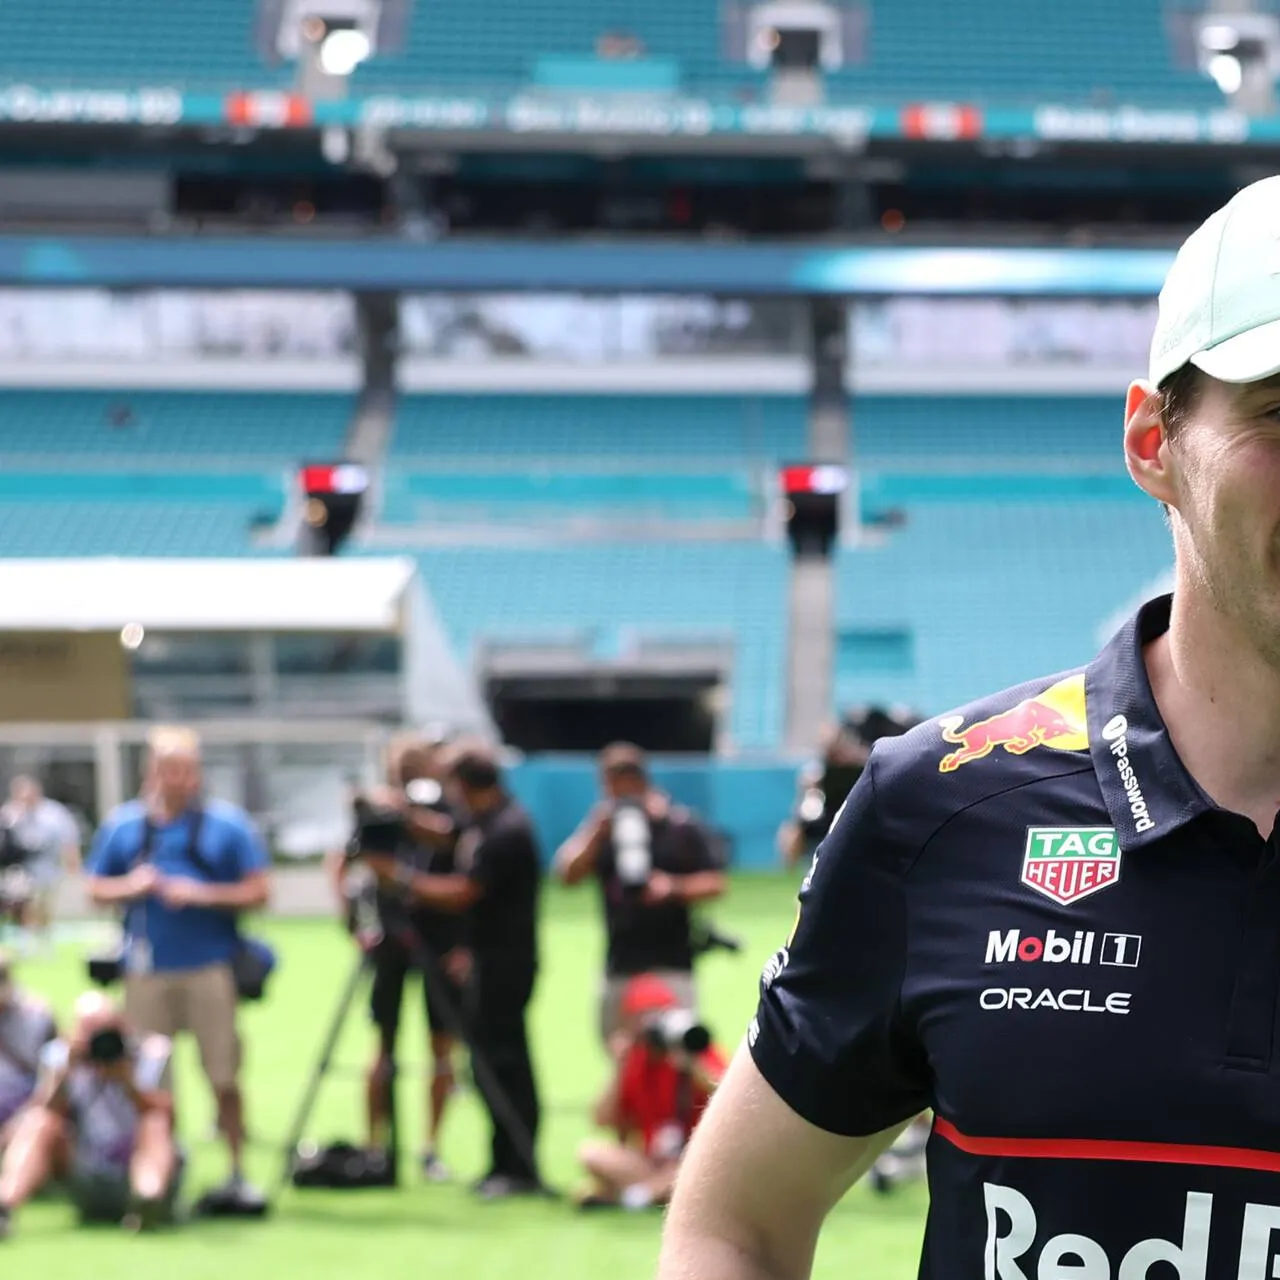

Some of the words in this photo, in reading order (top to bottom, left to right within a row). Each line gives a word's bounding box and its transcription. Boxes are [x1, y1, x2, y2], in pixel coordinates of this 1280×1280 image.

[1110, 735, 1155, 832] 1Password
[1036, 833, 1114, 856] TAG
[1028, 862, 1113, 898] HEUER
[985, 930, 1094, 965] Mobil
[980, 988, 1132, 1014] ORACLE
